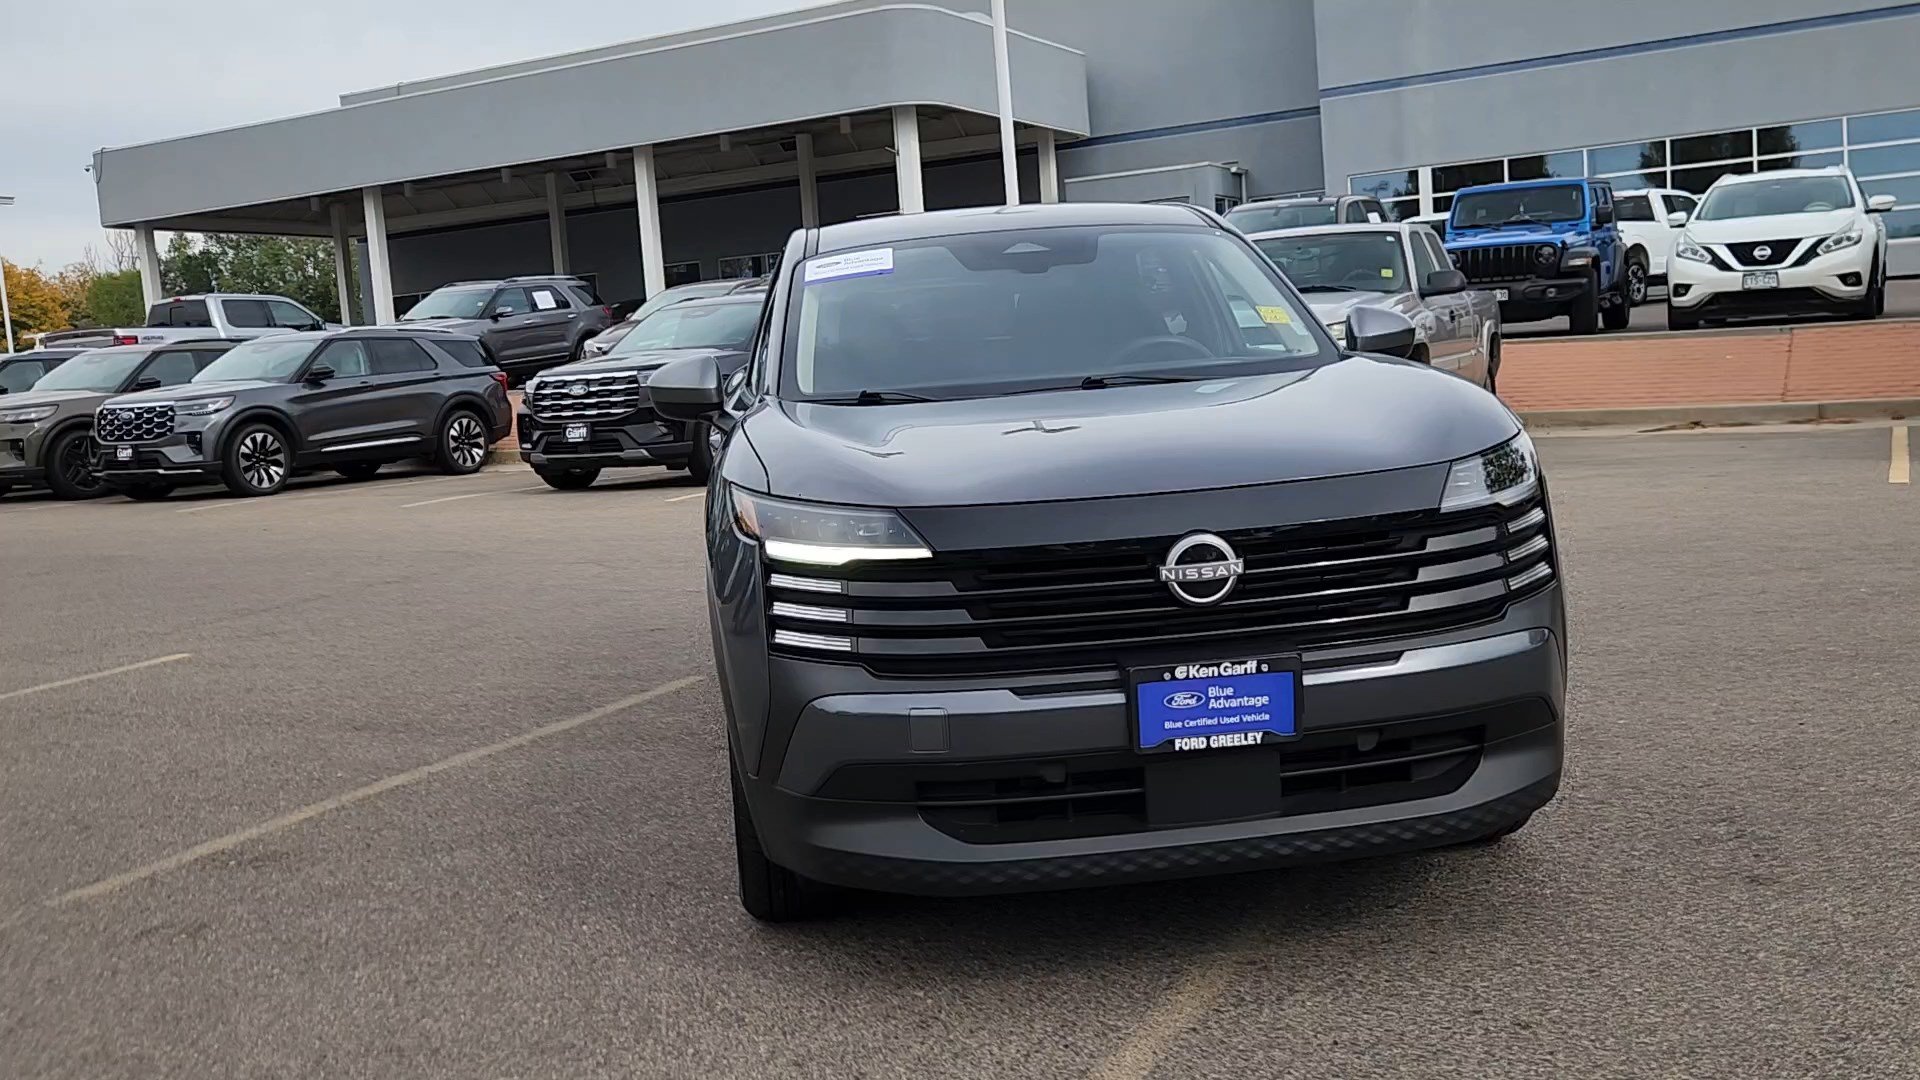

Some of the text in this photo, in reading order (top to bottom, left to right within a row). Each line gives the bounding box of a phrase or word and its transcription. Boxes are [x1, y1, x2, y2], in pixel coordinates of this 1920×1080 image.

[1161, 563, 1243, 581] NISSAN
[1188, 660, 1258, 679] Ken Garff
[1171, 694, 1199, 706] Ford
[1208, 686, 1234, 697] Blue
[1208, 695, 1270, 709] Advantage
[1164, 712, 1270, 729] Blue Certified Used Vehicle
[1174, 732, 1264, 751] FORD GREELEY
